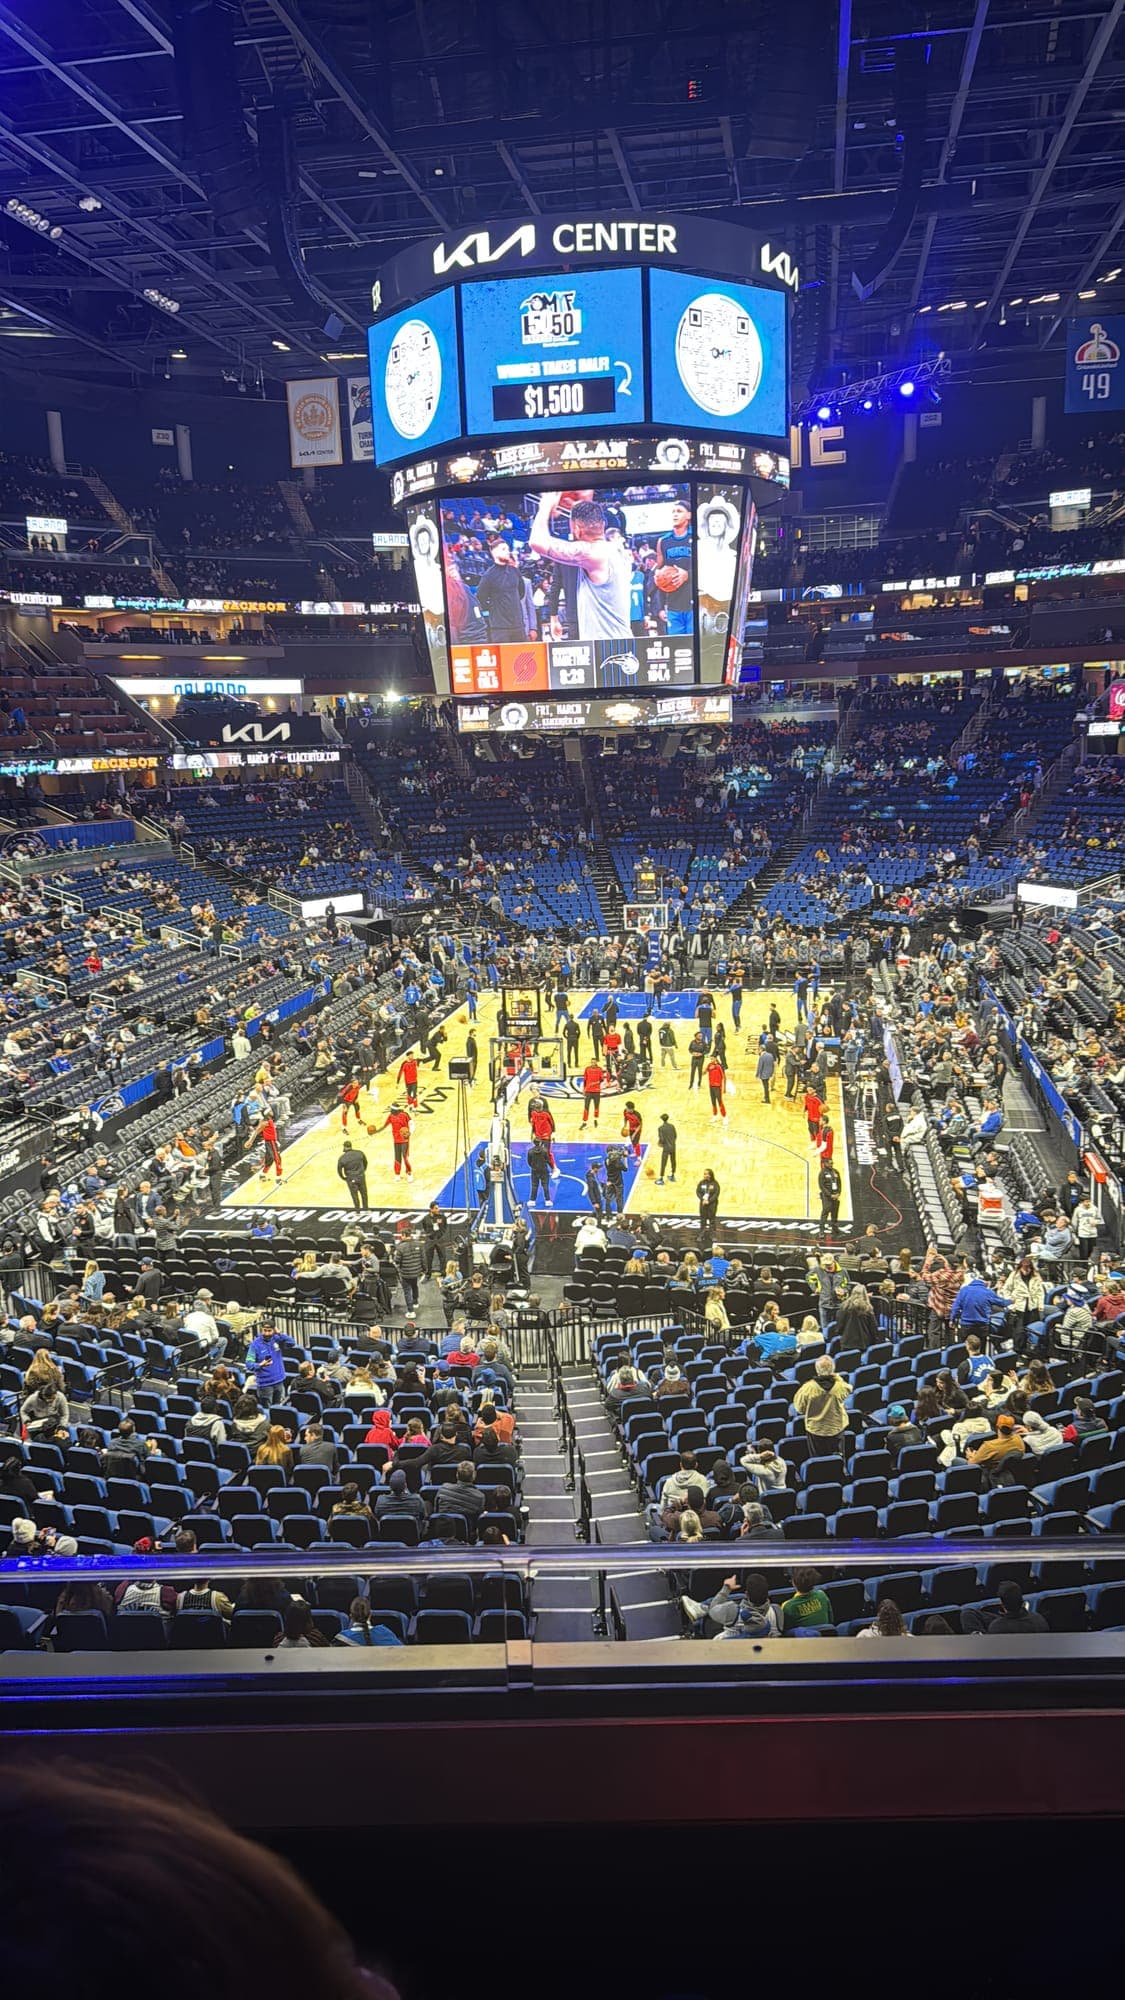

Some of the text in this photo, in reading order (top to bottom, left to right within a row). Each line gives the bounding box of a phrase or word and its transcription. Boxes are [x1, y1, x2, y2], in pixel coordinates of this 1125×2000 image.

[433, 223, 677, 274] KIA CENTER
[1082, 373, 1110, 400] 49
[524, 383, 584, 418] $1,500
[562, 442, 628, 459] ALAN
[563, 458, 628, 470] JACKSON
[223, 600, 287, 613] JACKSON
[585, 703, 592, 714] 7
[222, 722, 291, 743] KIA
[92, 757, 158, 770] JACKSON
[317, 1208, 469, 1225] OLANDO
